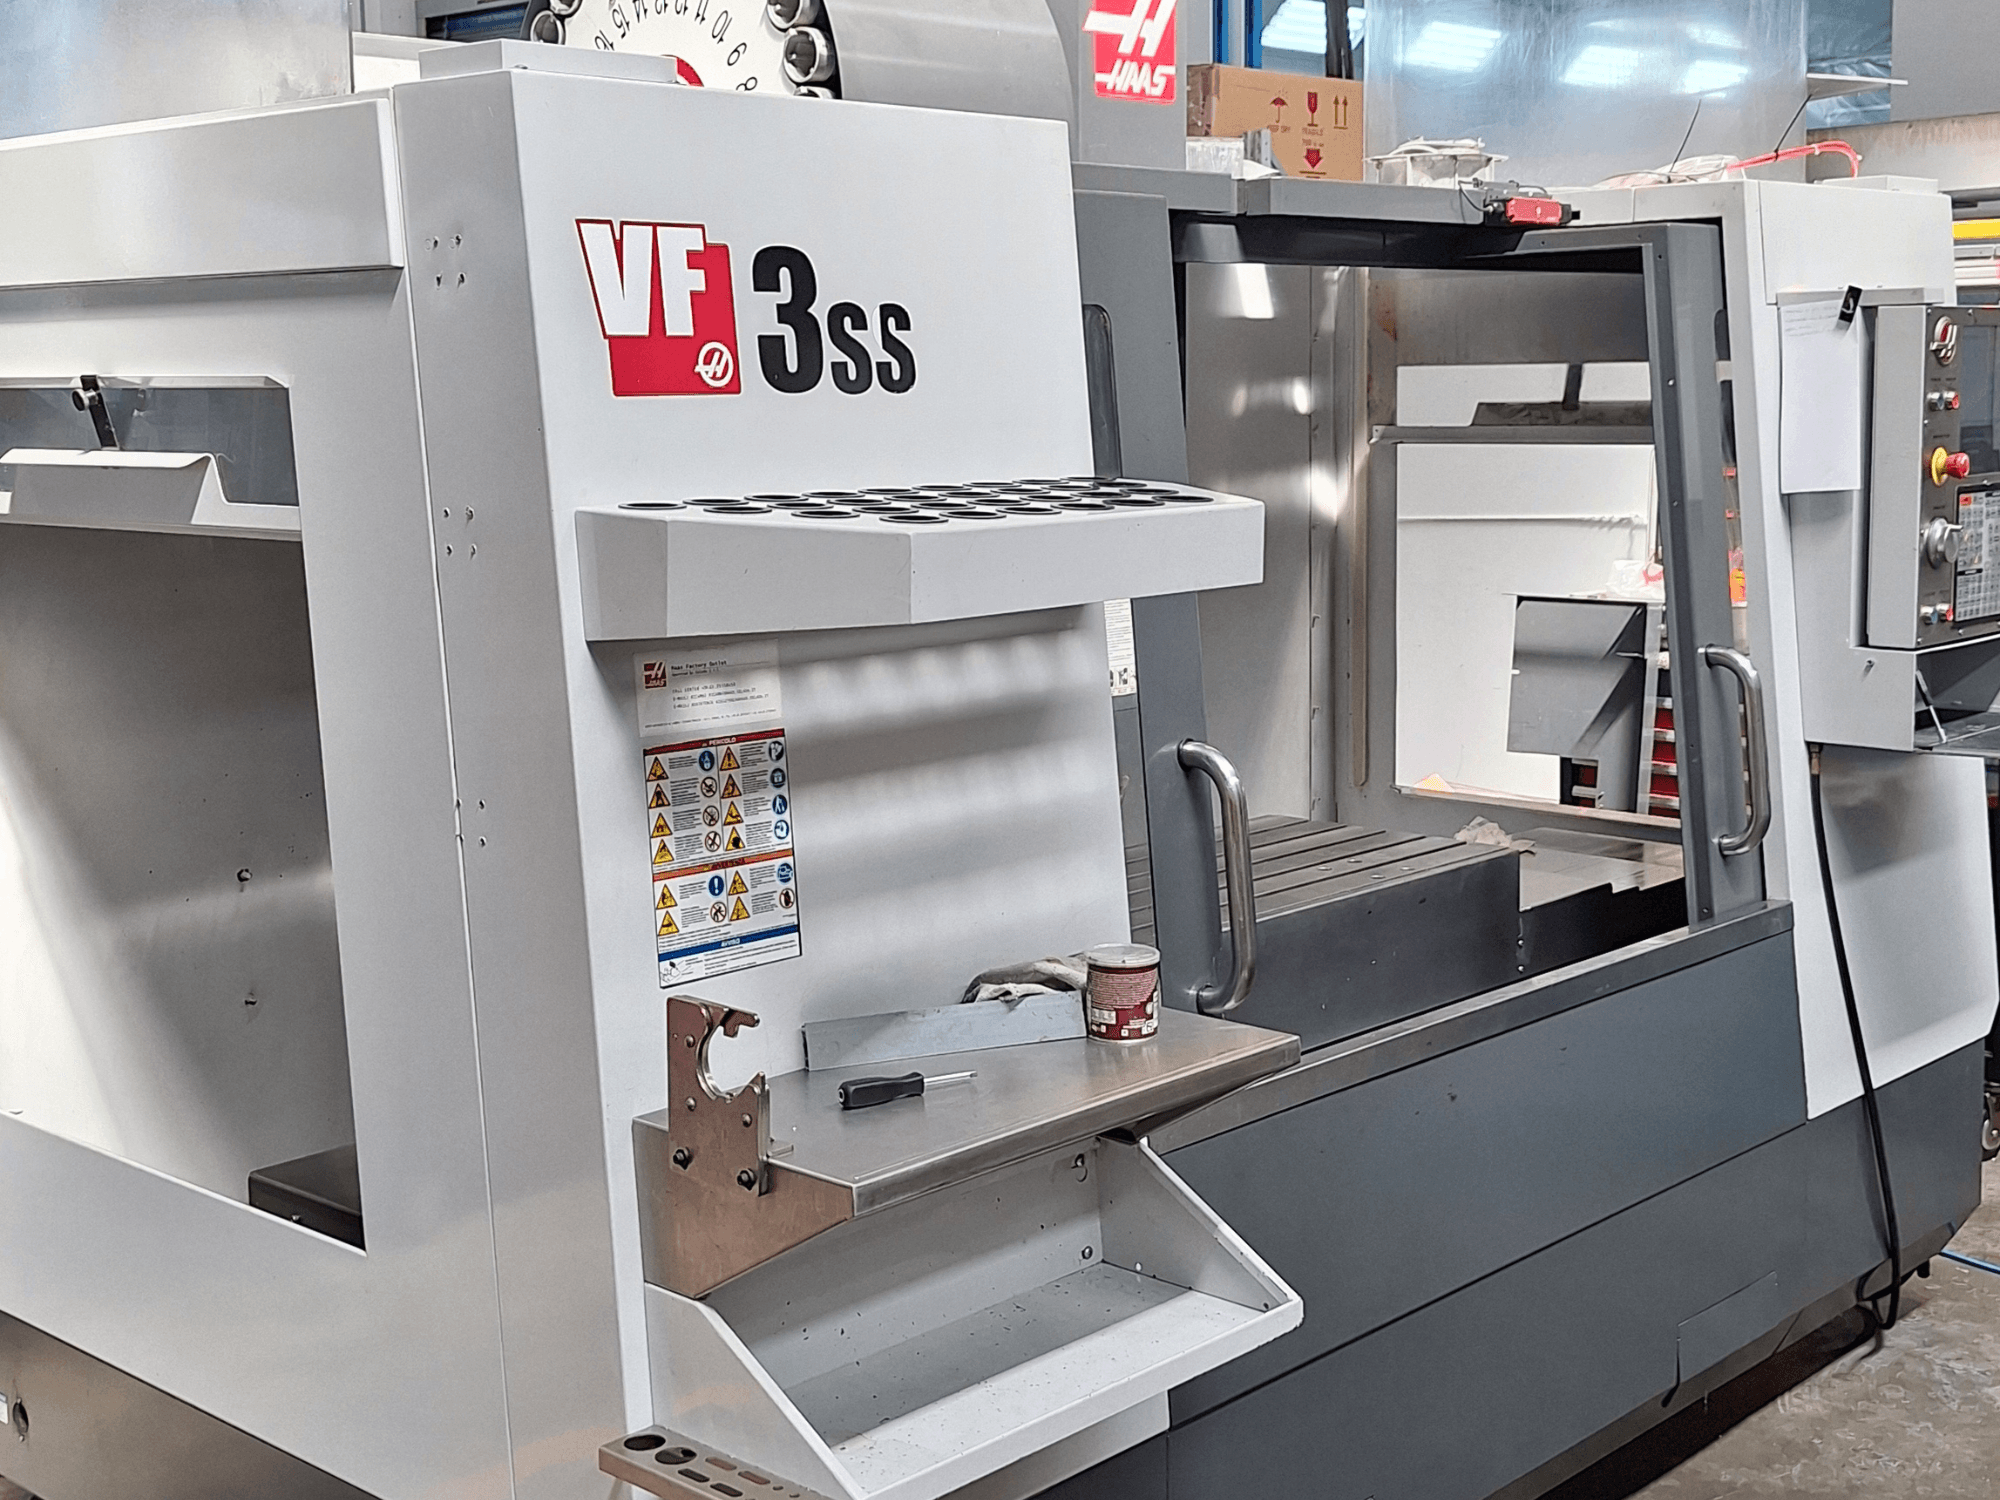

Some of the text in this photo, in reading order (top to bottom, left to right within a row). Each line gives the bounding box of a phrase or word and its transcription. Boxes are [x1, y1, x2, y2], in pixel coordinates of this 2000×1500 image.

[611, 4, 630, 39] 15
[711, 10, 733, 44] 10
[727, 42, 747, 66] 9
[1094, 58, 1176, 96] HAAS
[576, 219, 706, 339] VF
